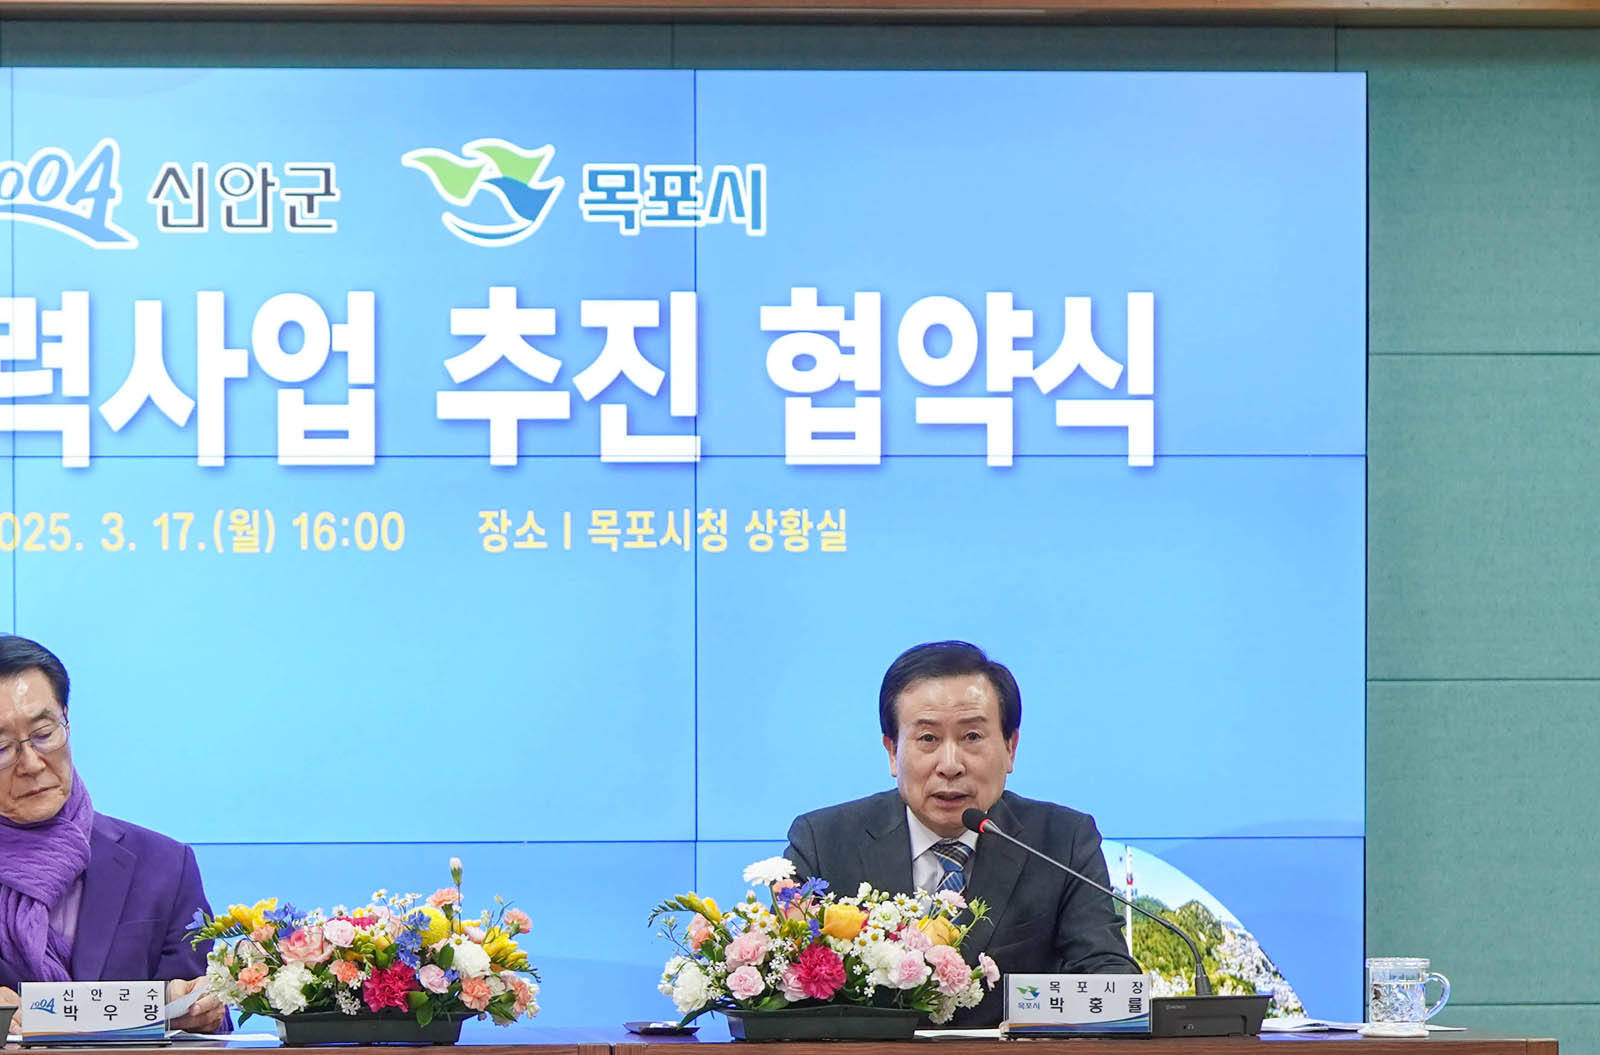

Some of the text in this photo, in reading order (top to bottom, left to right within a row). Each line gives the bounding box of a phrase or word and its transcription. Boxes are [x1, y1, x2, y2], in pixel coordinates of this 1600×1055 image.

[147, 161, 341, 233] 신안군
[579, 163, 767, 236] 목포시
[436, 287, 701, 467] 추진
[760, 287, 1155, 467] 협약식
[100, 511, 137, 552] 3.
[292, 510, 406, 552] 16:00
[477, 508, 549, 553] 장소
[587, 508, 728, 553] 목포시청
[744, 508, 848, 553] 상황실
